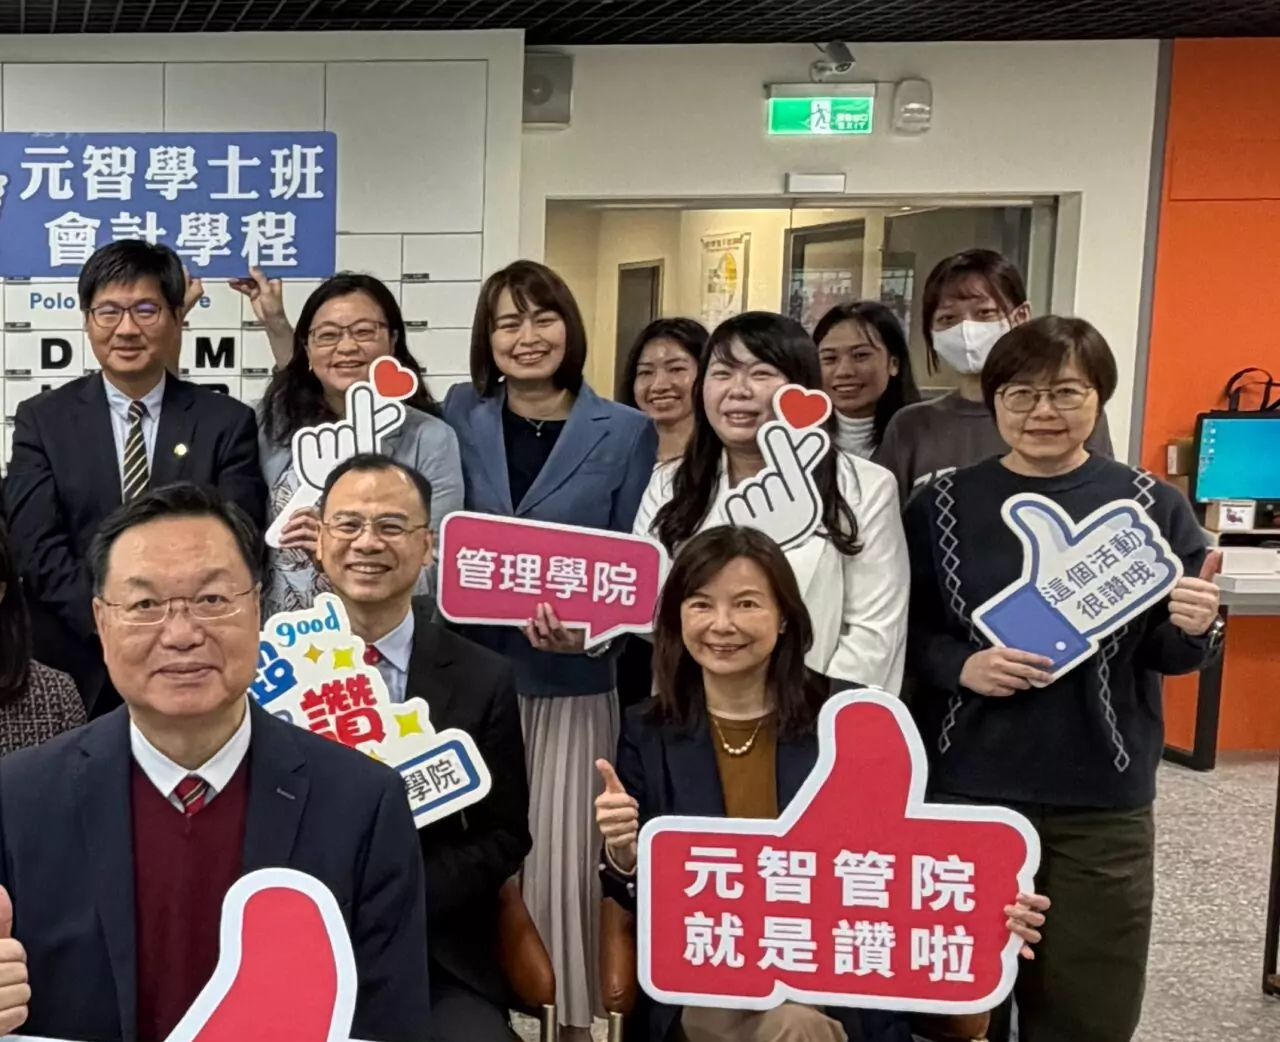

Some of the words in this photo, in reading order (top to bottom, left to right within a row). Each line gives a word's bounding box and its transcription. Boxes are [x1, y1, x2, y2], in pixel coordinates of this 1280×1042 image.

[19, 144, 325, 201] 元智學士班
[455, 546, 638, 606] 管理學院
[1040, 528, 1143, 606] 這個活動
[1076, 560, 1156, 621] 很讚哦
[275, 601, 342, 648] good
[683, 845, 976, 913] 元智管院
[683, 910, 976, 983] 就是讚啦
